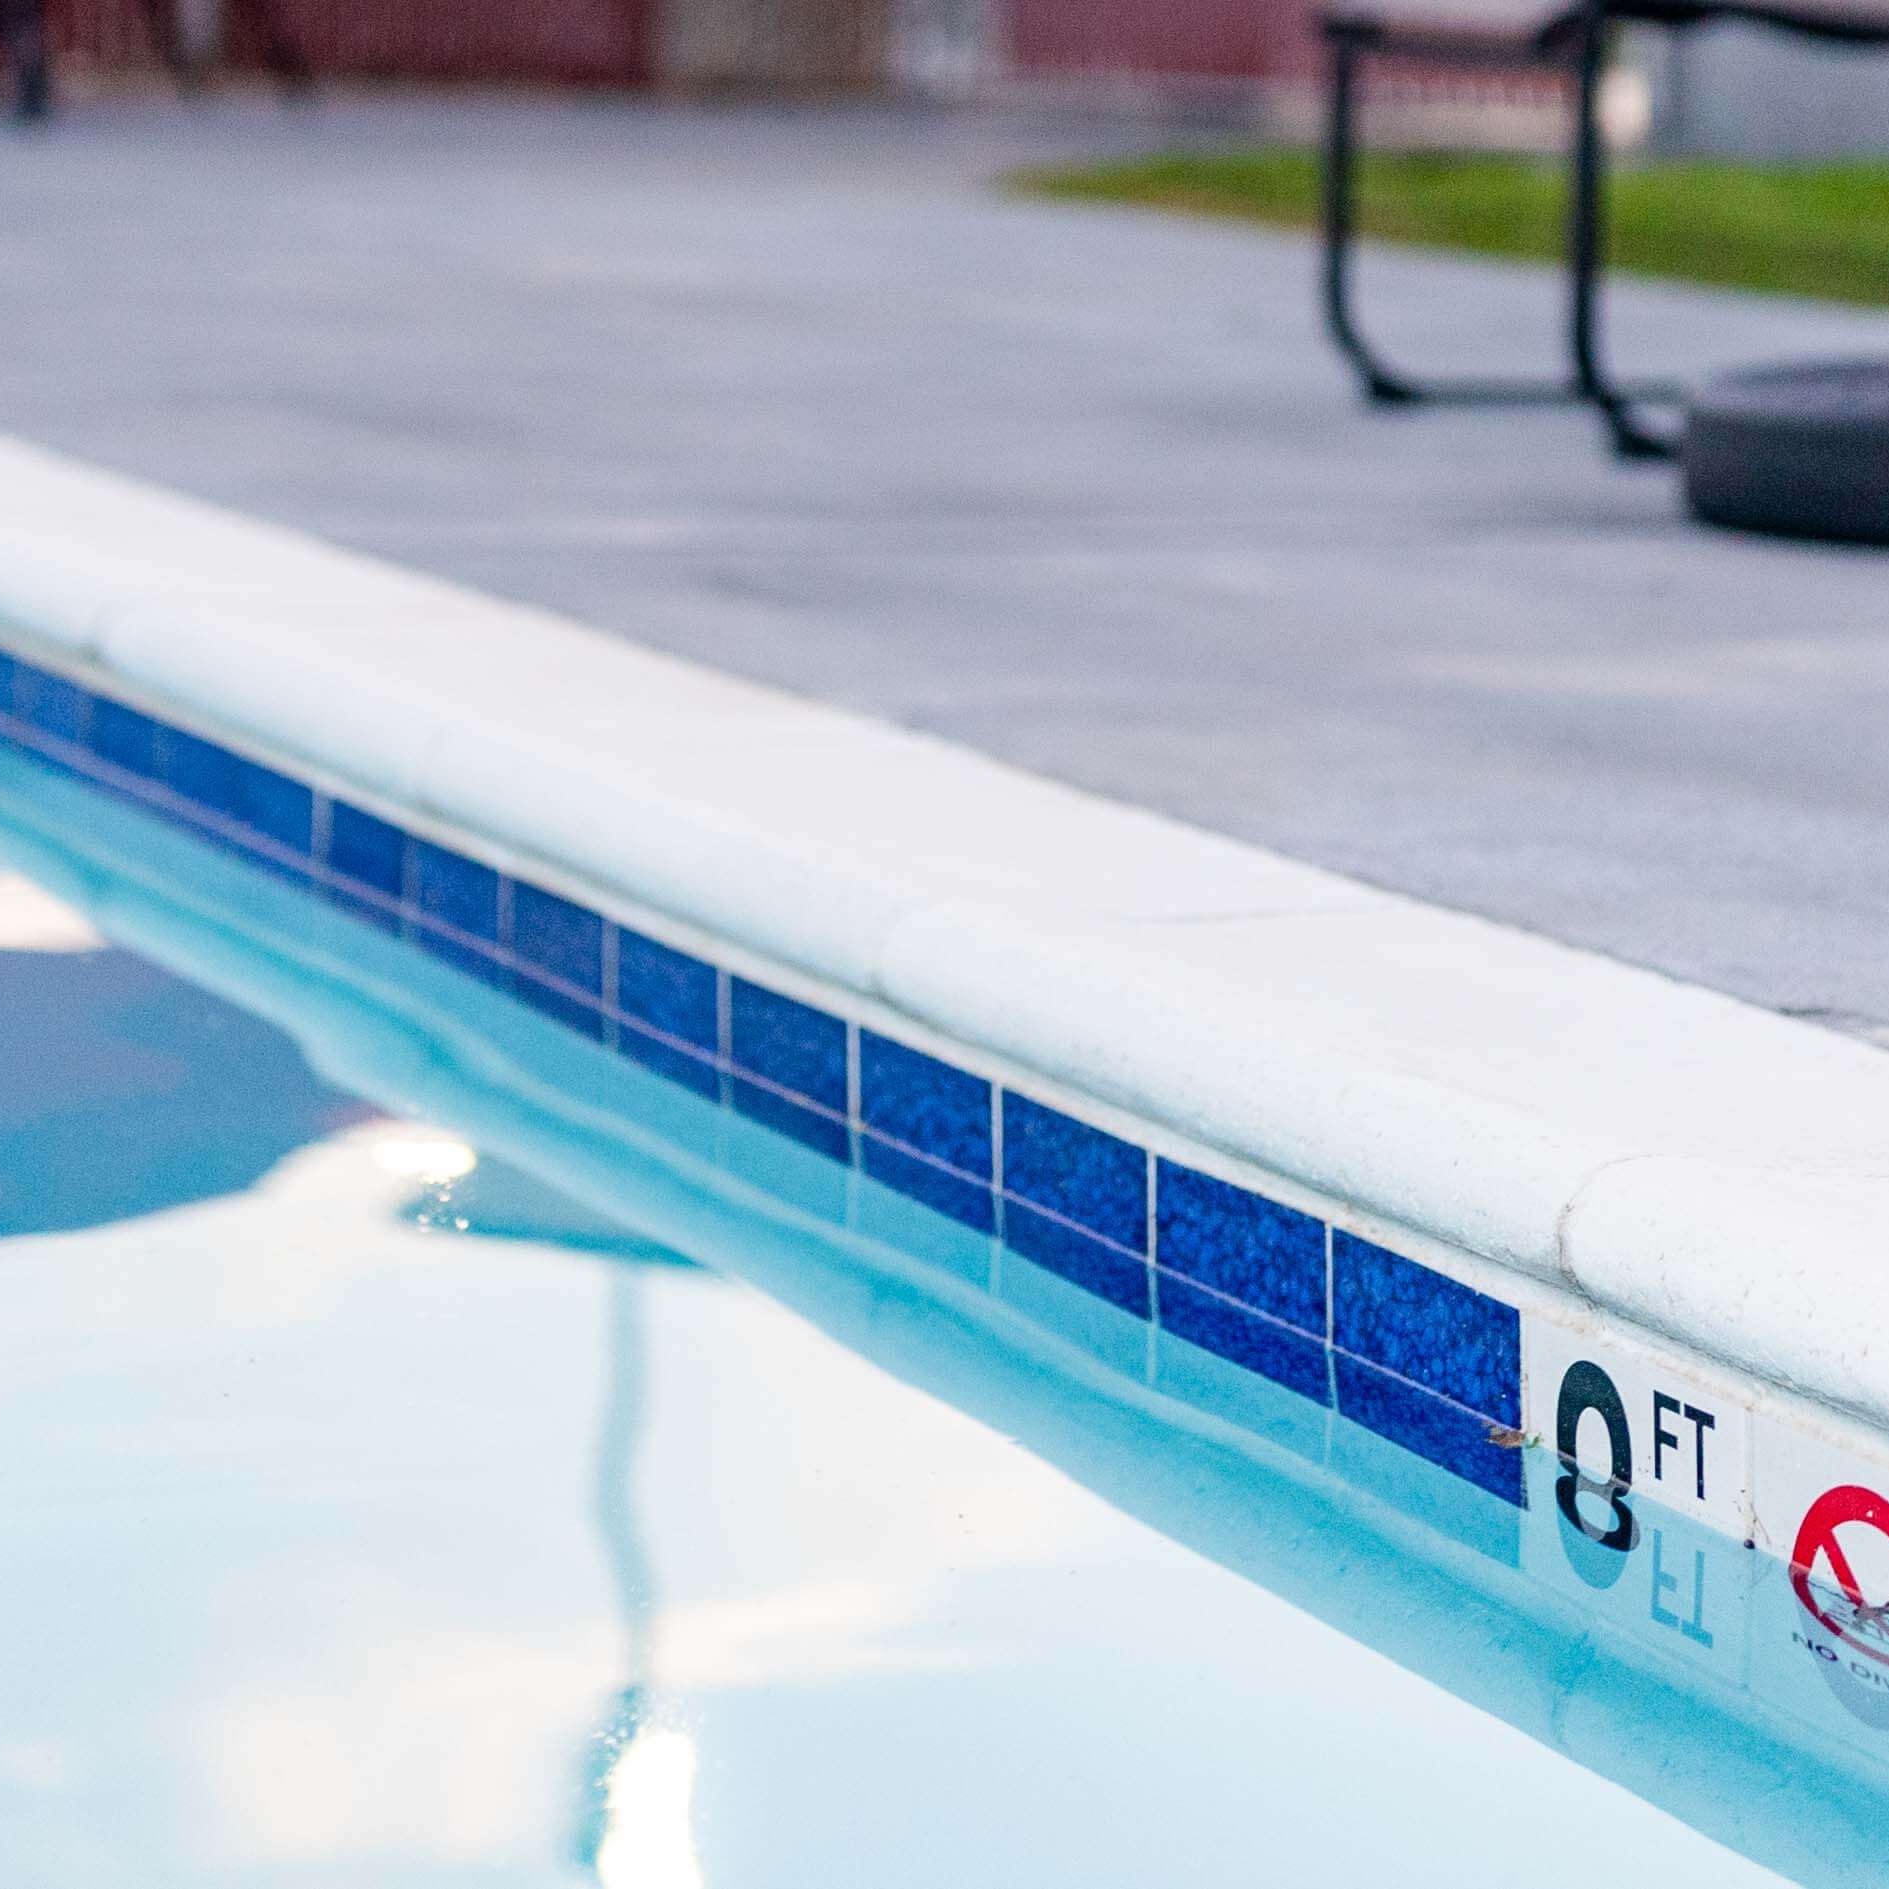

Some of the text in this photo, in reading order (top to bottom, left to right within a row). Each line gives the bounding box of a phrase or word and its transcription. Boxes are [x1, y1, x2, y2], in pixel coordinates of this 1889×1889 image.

[1556, 1360, 1715, 1551] 8 FT
[1792, 1631, 1839, 1661] NO
